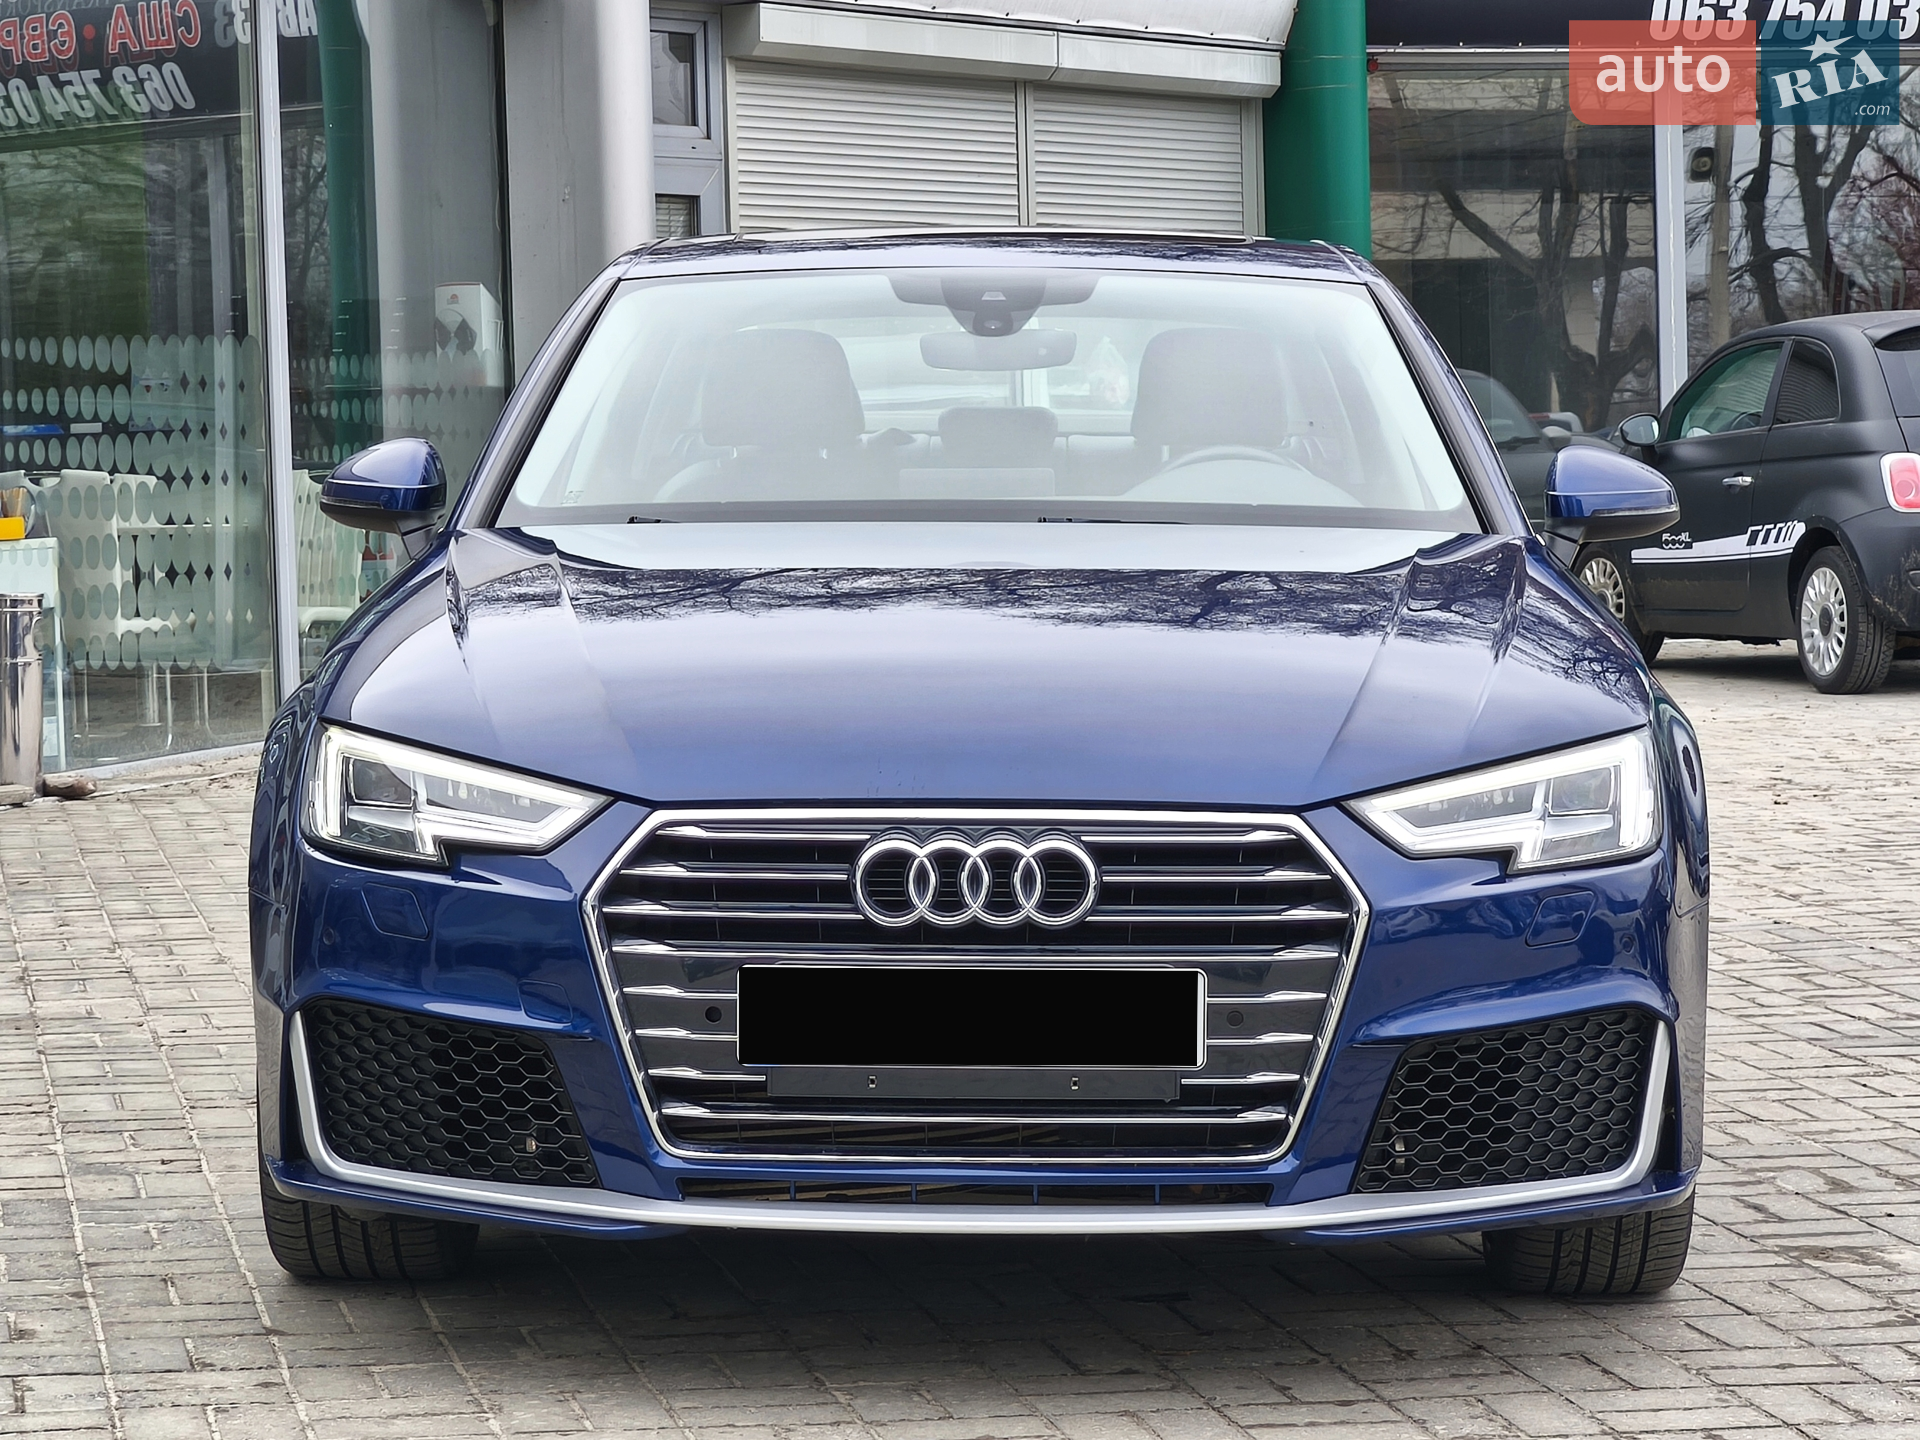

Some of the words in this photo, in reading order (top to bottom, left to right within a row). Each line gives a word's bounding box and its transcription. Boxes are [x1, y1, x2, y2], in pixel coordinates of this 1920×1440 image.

[1649, 0, 1748, 41] 063
[1758, 0, 1847, 41] 754
[1856, 0, 1920, 41] 03
